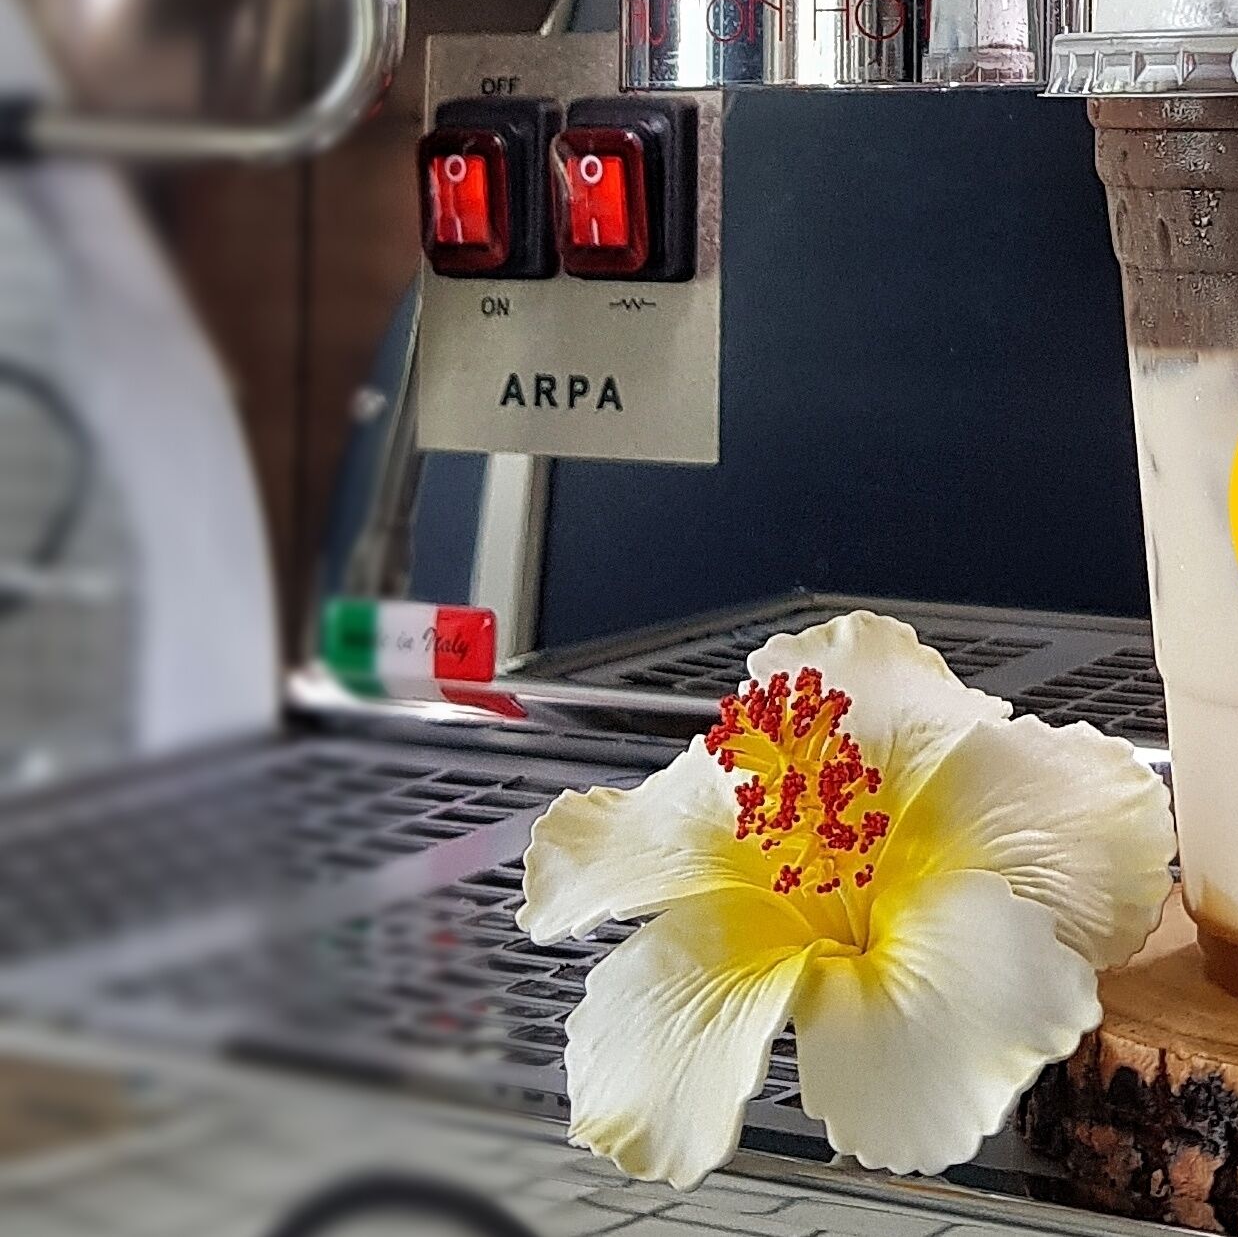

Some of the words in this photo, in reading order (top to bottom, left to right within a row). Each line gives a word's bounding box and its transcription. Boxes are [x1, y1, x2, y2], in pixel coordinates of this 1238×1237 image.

[481, 77, 520, 94] OFF
[481, 297, 510, 316] ON
[501, 372, 624, 413] ARPA
